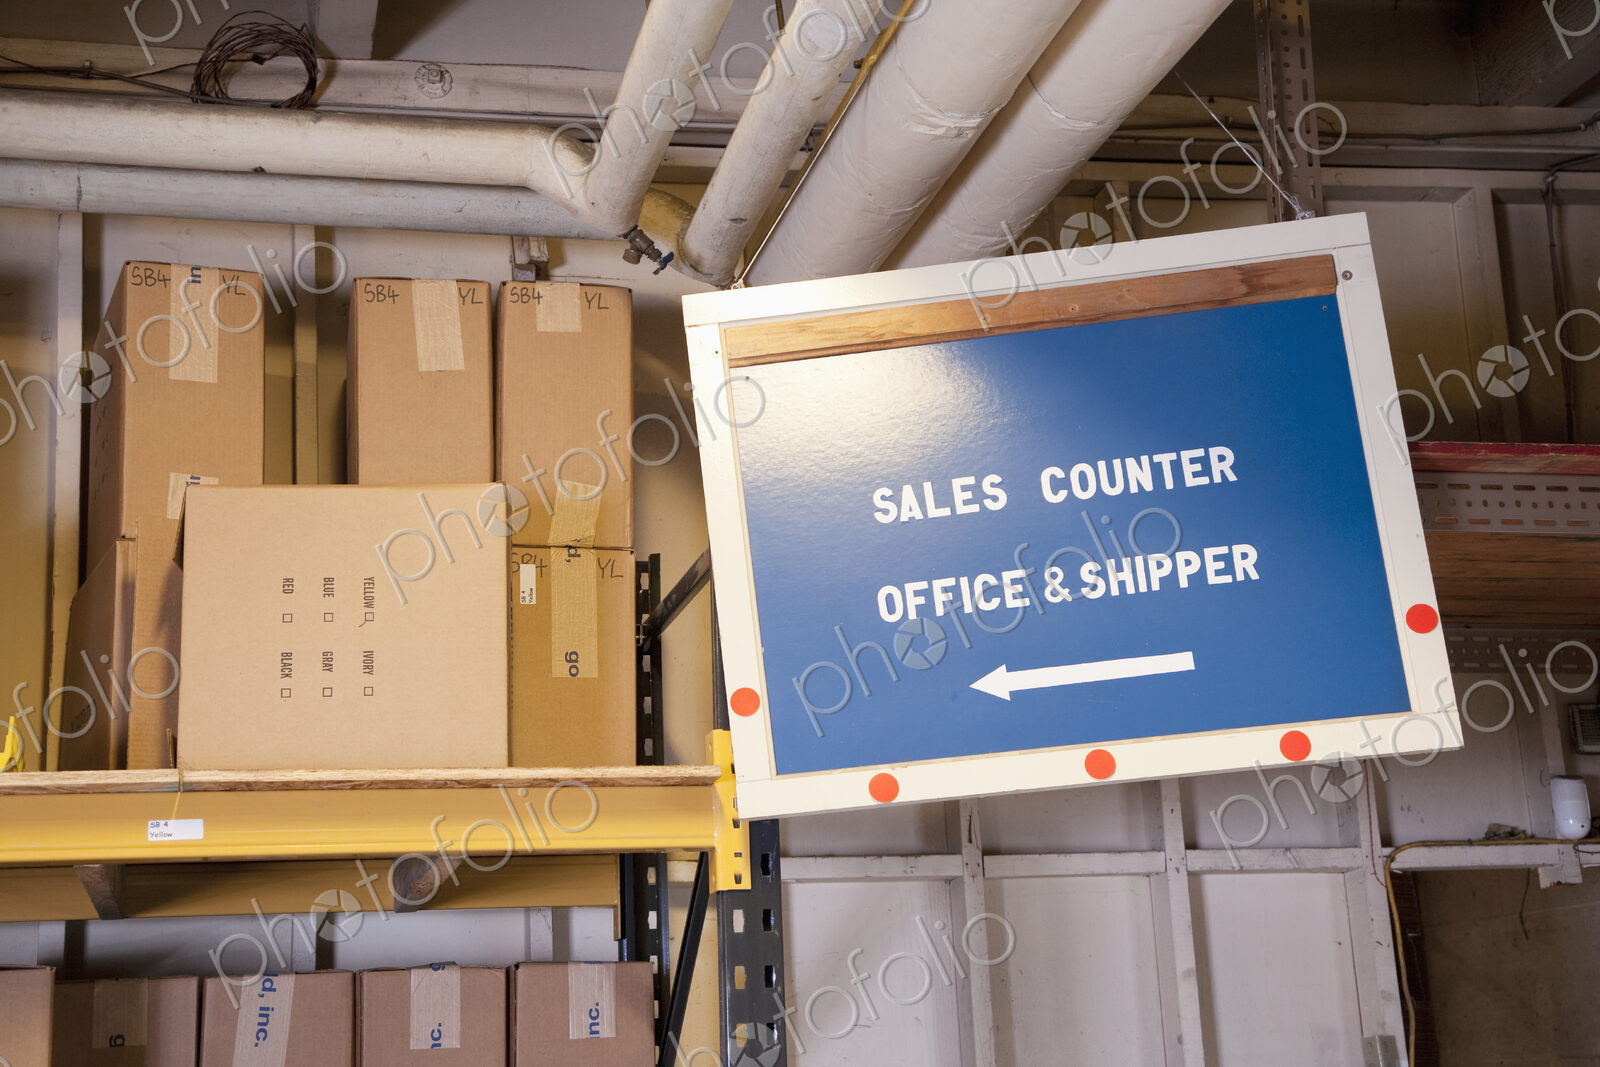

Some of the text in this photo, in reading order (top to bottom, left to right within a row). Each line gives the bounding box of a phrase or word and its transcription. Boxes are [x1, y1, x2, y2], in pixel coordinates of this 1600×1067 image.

[131, 266, 172, 288] SB4
[222, 275, 246, 296] YL
[363, 283, 400, 304] SB4
[457, 287, 485, 305] YL
[510, 286, 544, 304] SB4
[584, 290, 610, 310] YL
[872, 446, 1238, 525] SALES COUNTER
[597, 557, 624, 579] YL
[282, 577, 295, 595] RED
[323, 577, 335, 598] BLUE
[363, 576, 375, 609] YELLOW
[877, 543, 1260, 623] OFFICE & SHIPPER
[280, 652, 293, 679] BLACK
[322, 651, 334, 673] GRAY
[362, 650, 374, 676] IVORY
[254, 1006, 274, 1047] inc.
